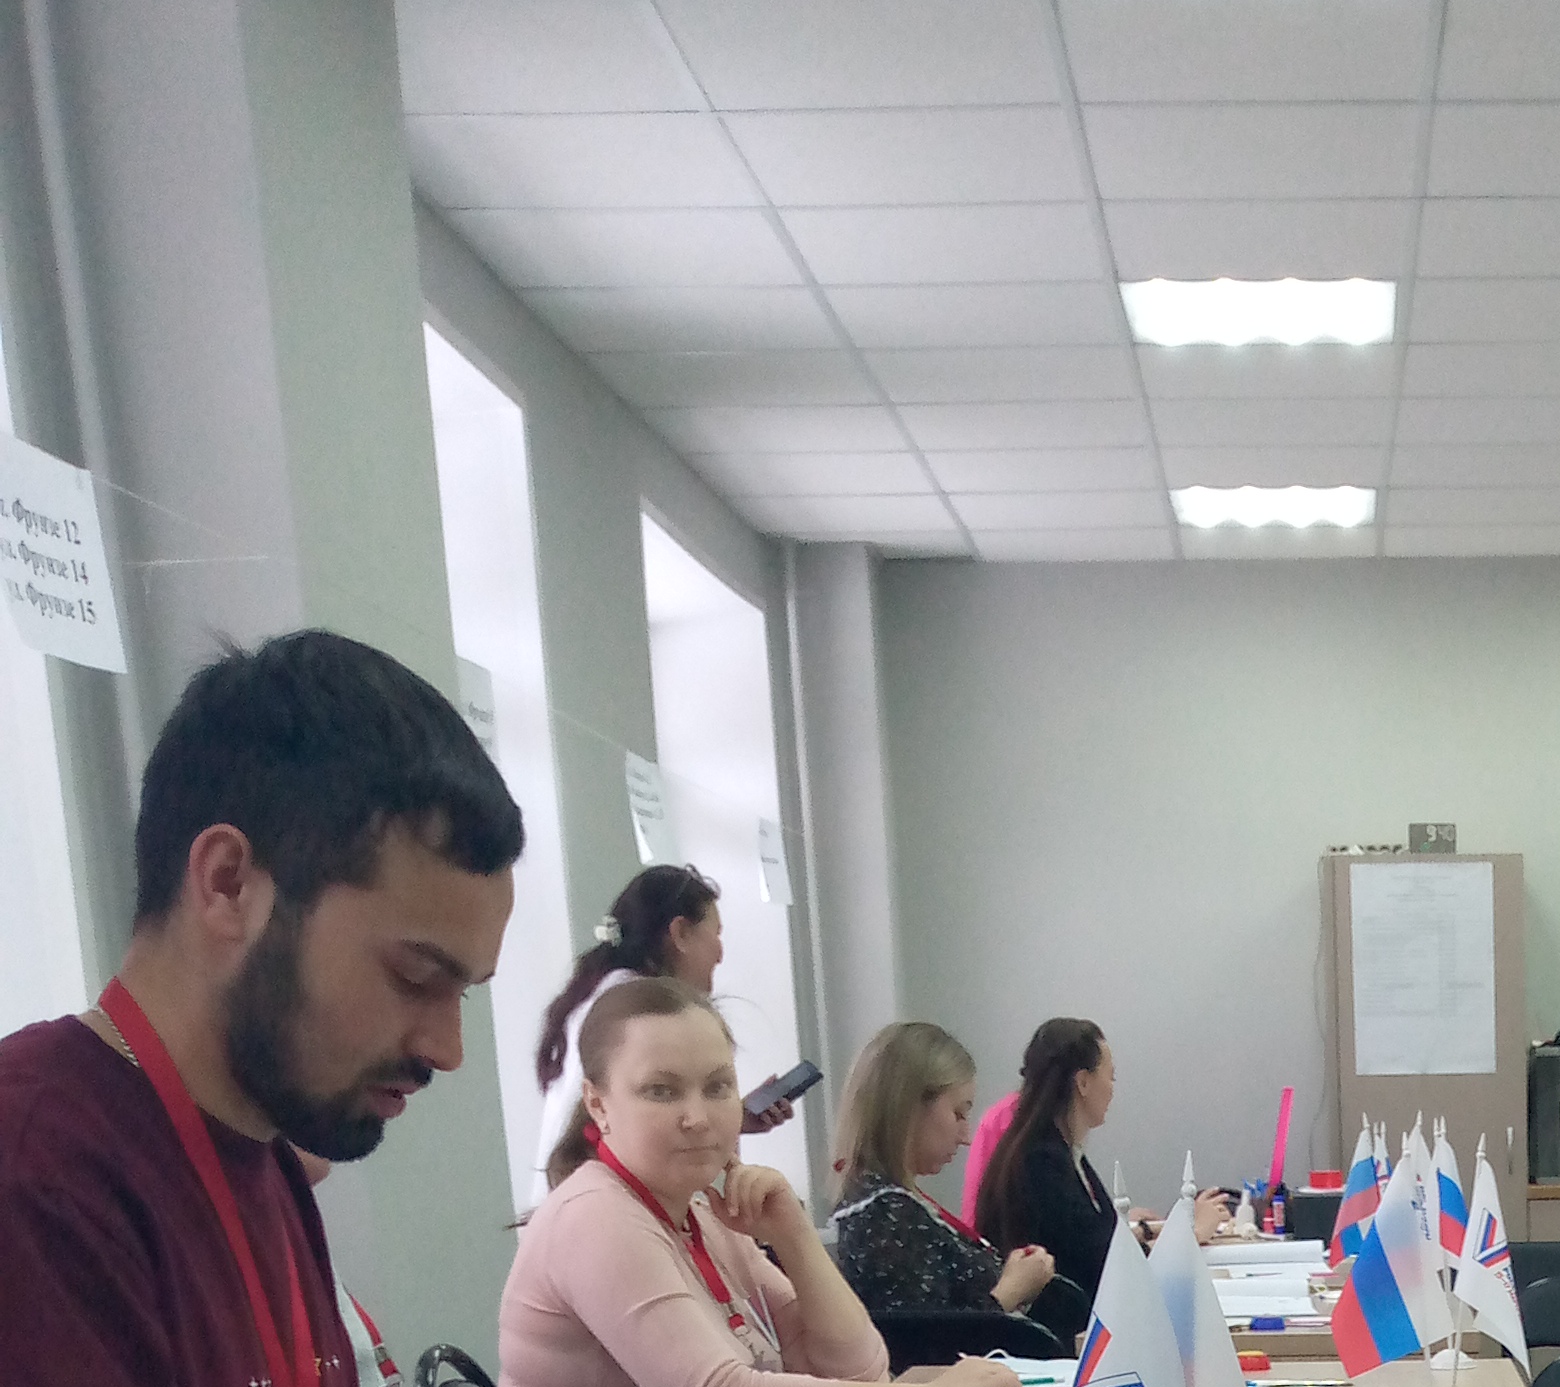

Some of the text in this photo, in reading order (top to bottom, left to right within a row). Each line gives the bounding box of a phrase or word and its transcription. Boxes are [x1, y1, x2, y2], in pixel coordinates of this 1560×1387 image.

[64, 519, 81, 545] 12
[71, 559, 89, 585] 14
[78, 599, 96, 625] 15
